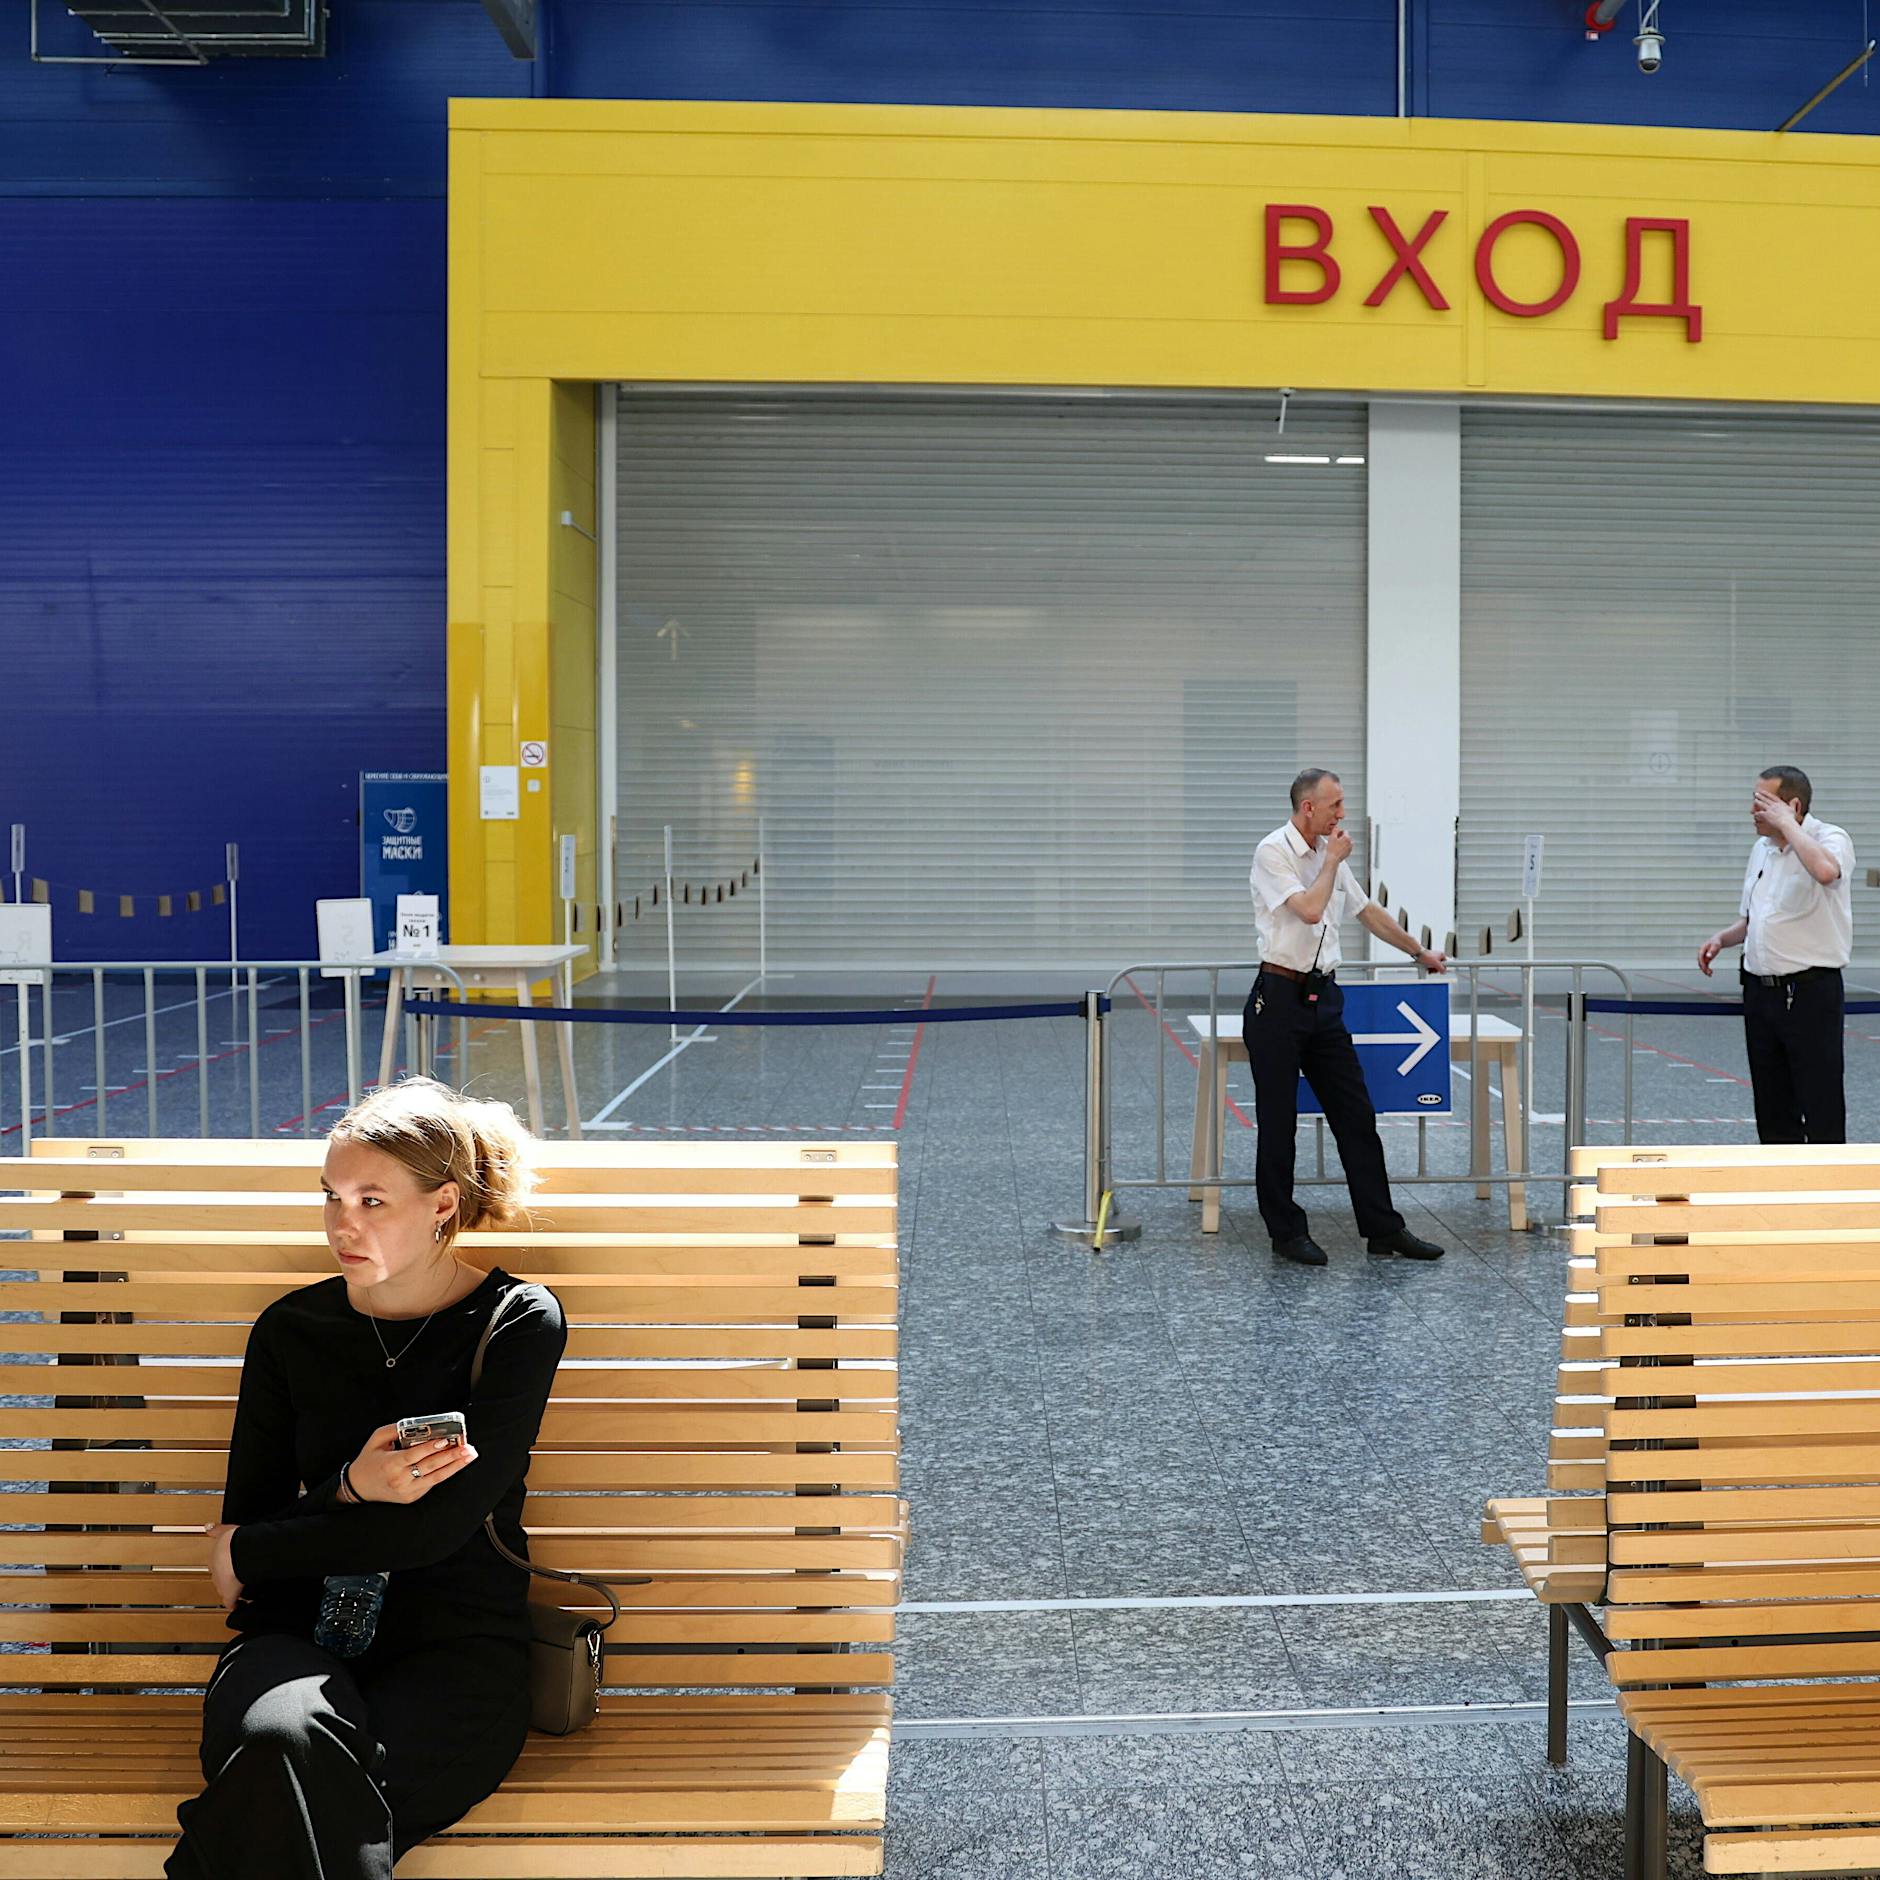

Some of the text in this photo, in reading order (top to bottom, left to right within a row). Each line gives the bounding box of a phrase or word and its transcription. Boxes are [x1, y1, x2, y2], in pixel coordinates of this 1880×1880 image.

[1264, 204, 1702, 343] ВХОД
[382, 836, 422, 845] ЗАЩИТНЫЕ
[382, 846, 423, 860] МАСКИ
